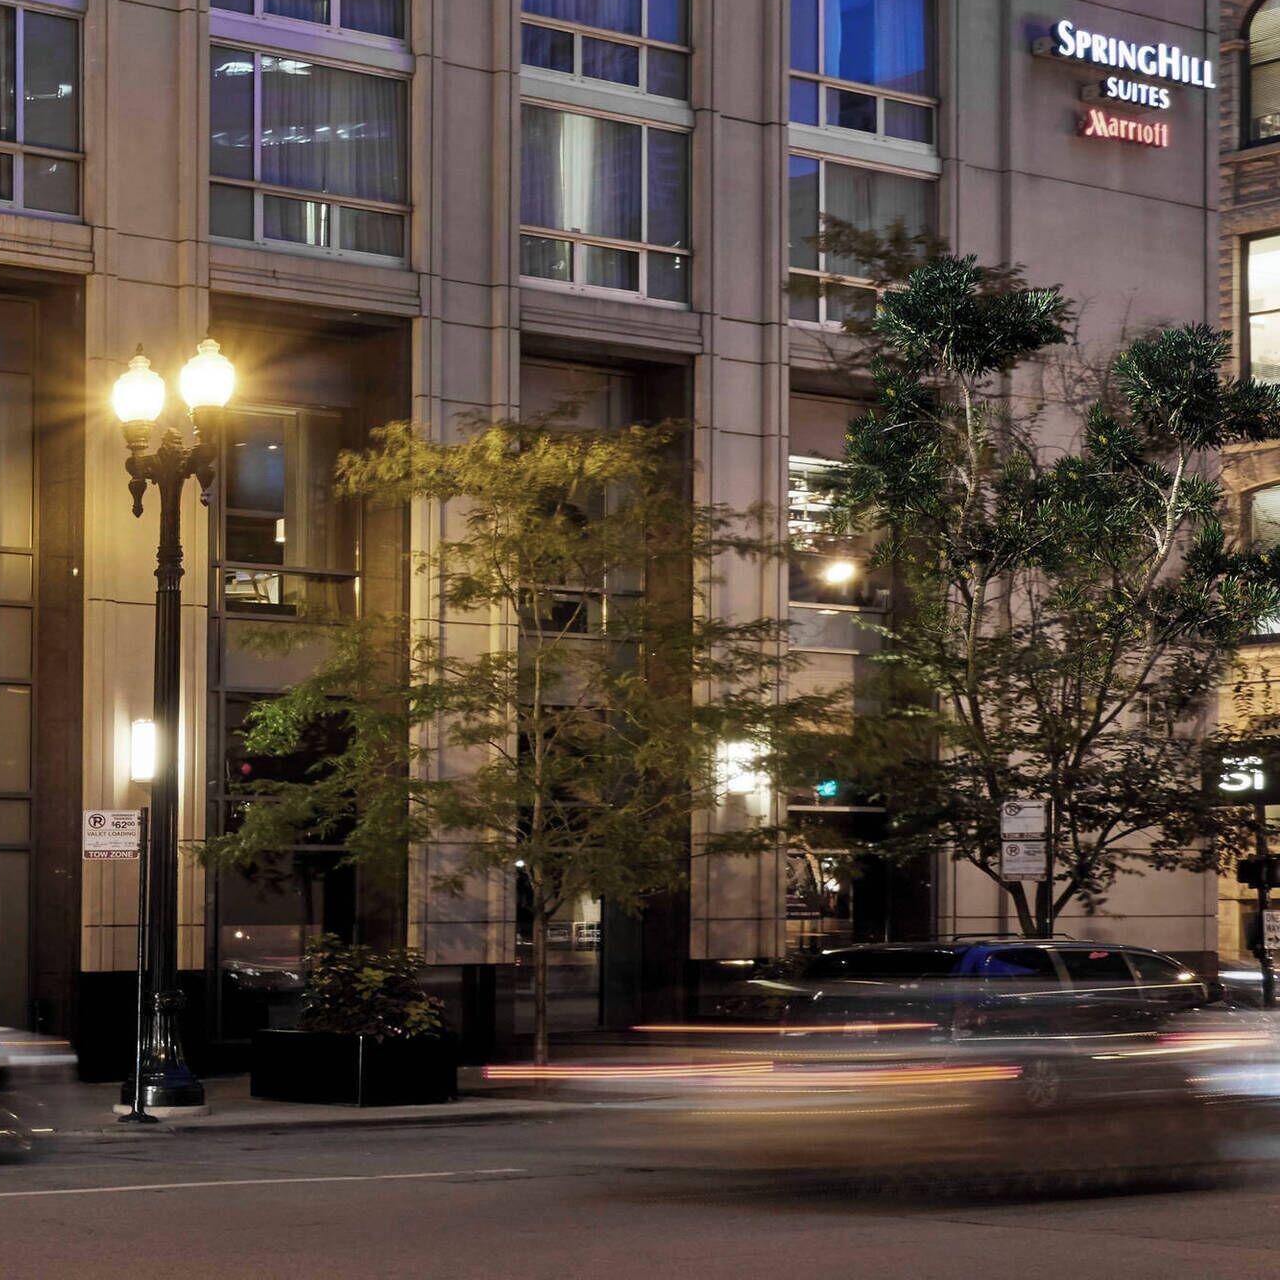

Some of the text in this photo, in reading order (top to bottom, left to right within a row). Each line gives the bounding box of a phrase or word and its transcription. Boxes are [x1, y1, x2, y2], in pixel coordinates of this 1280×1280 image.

[1057, 20, 1216, 89] SPRINGHILL
[1106, 76, 1171, 109] SUITES
[1085, 109, 1169, 148] Marriott
